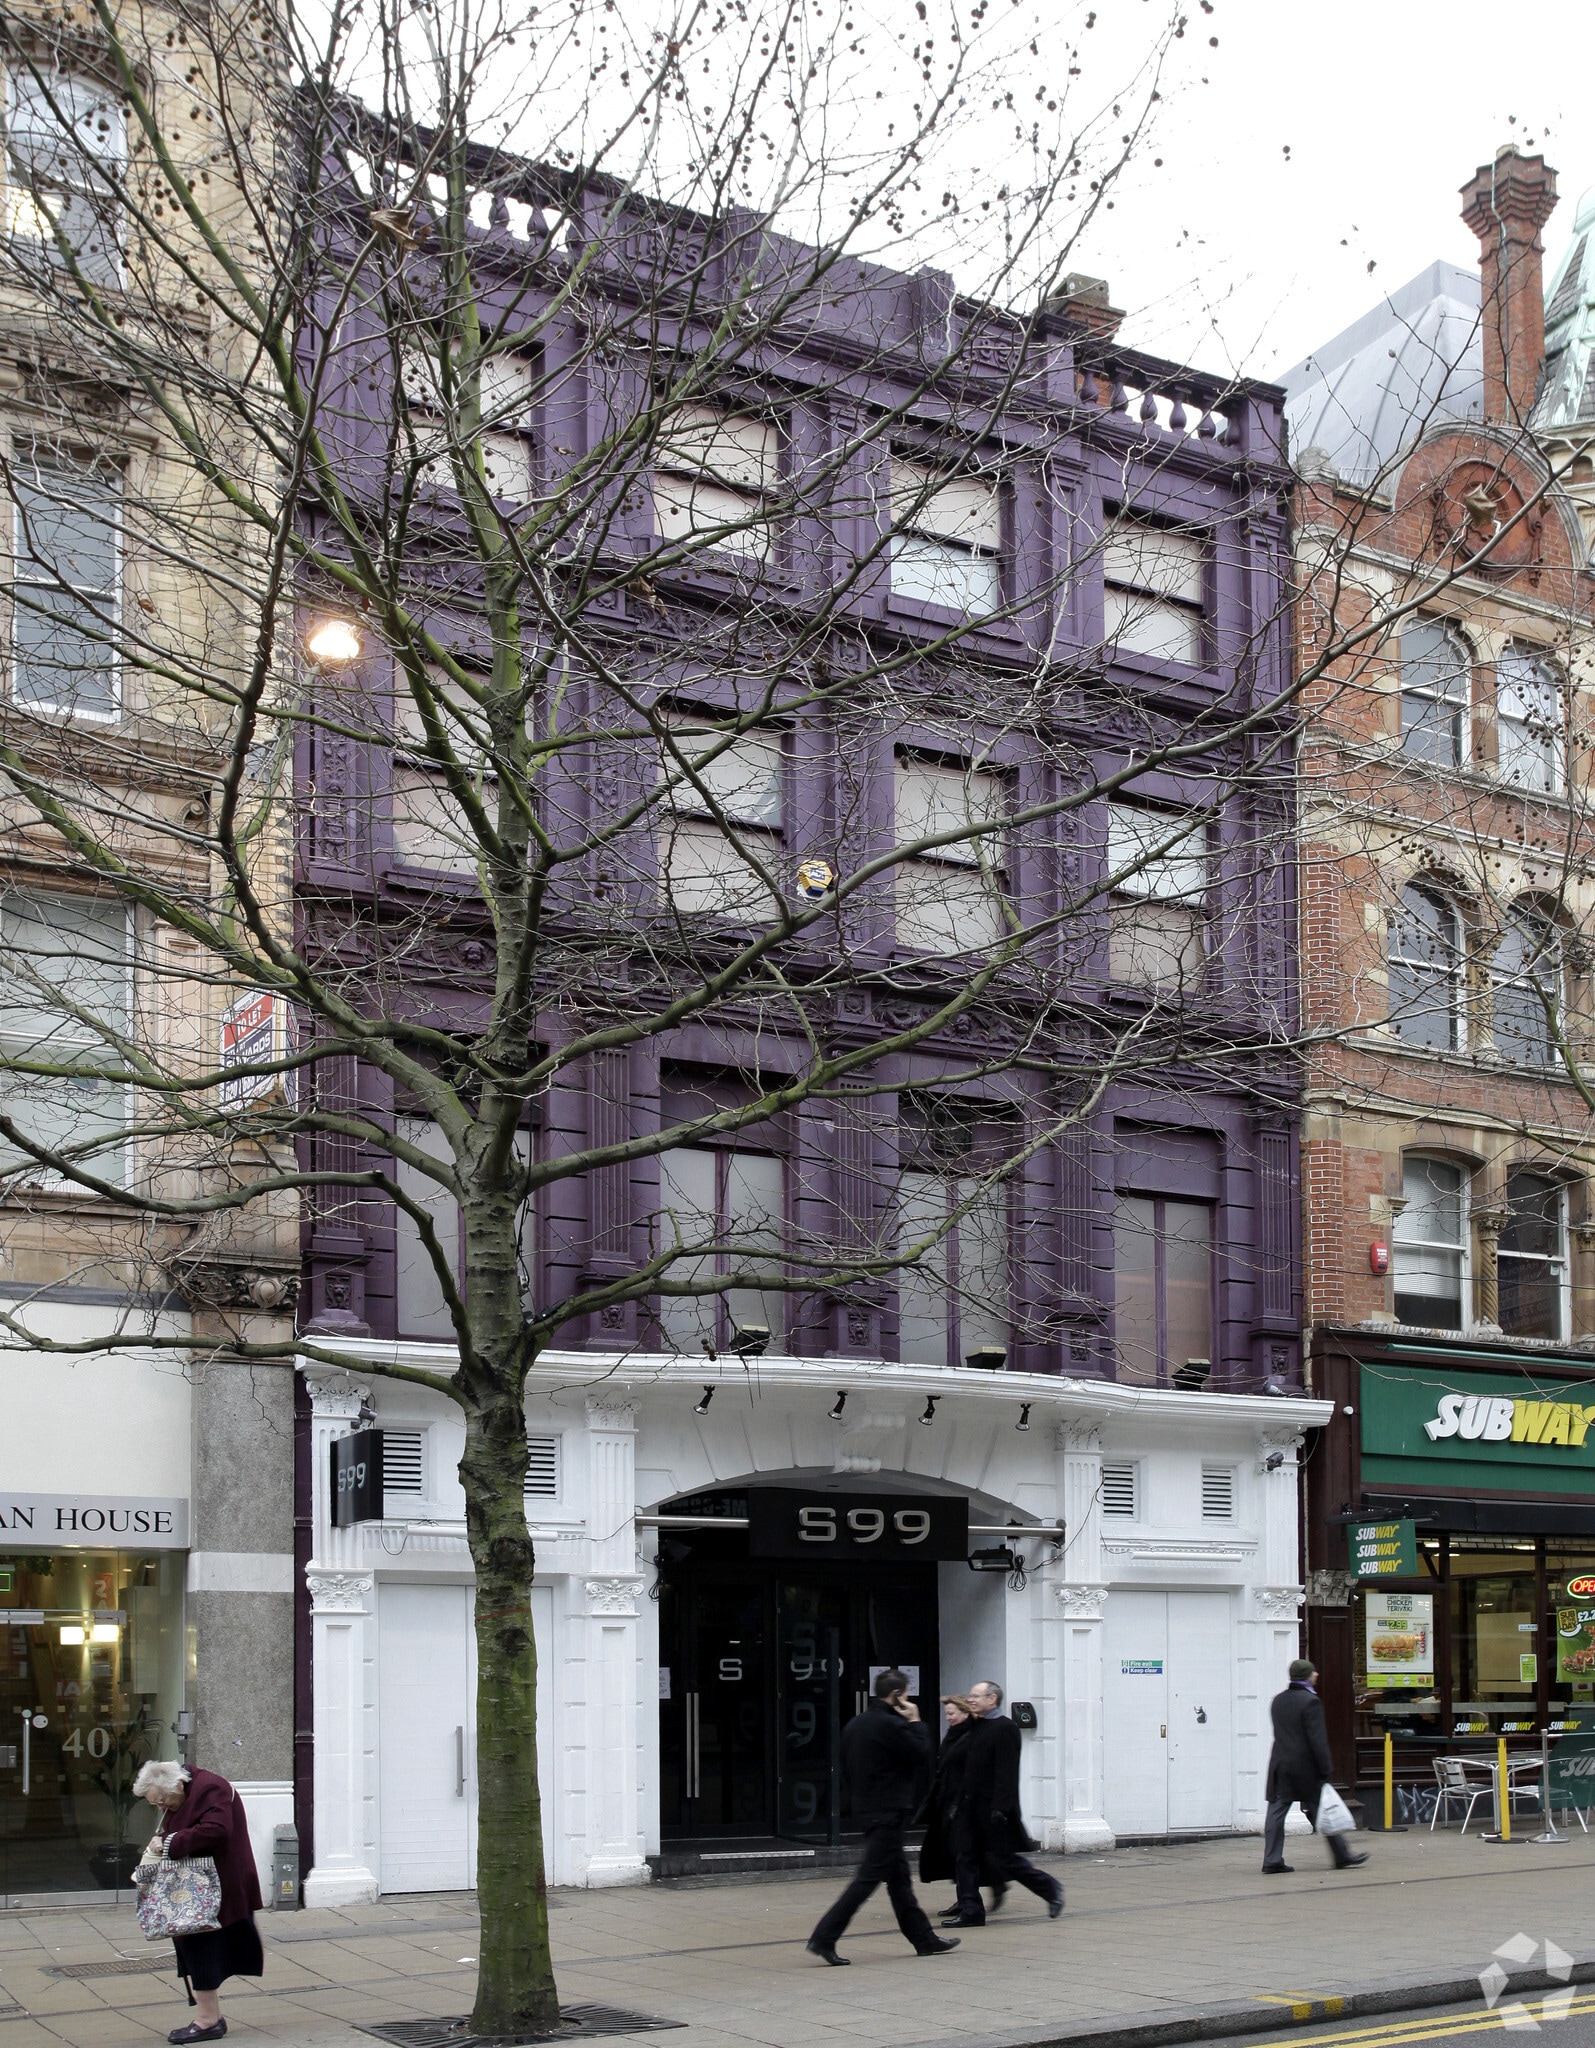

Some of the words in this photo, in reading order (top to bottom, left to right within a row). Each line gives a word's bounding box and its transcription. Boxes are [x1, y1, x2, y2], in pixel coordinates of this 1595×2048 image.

[237, 1018, 247, 1036] TO
[248, 1004, 262, 1026] LET
[1423, 1394, 1595, 1446] SUBWAY
[338, 1462, 366, 1492] S99
[55, 1508, 173, 1533] HOUSE
[798, 1507, 931, 1544] S99
[1355, 1524, 1400, 1541] SUBWAY
[1356, 1541, 1401, 1558] SUBWAY
[1358, 1558, 1403, 1575] SUBWAY
[1572, 1580, 1595, 1593] OPE
[1560, 1611, 1576, 1620] SUB
[1562, 1621, 1577, 1630] DAY
[1454, 1722, 1489, 1732] SUBWAY
[1501, 1721, 1535, 1732] SUBWAY
[1548, 1721, 1582, 1731] SUBWAY
[62, 1728, 110, 1758] 40
